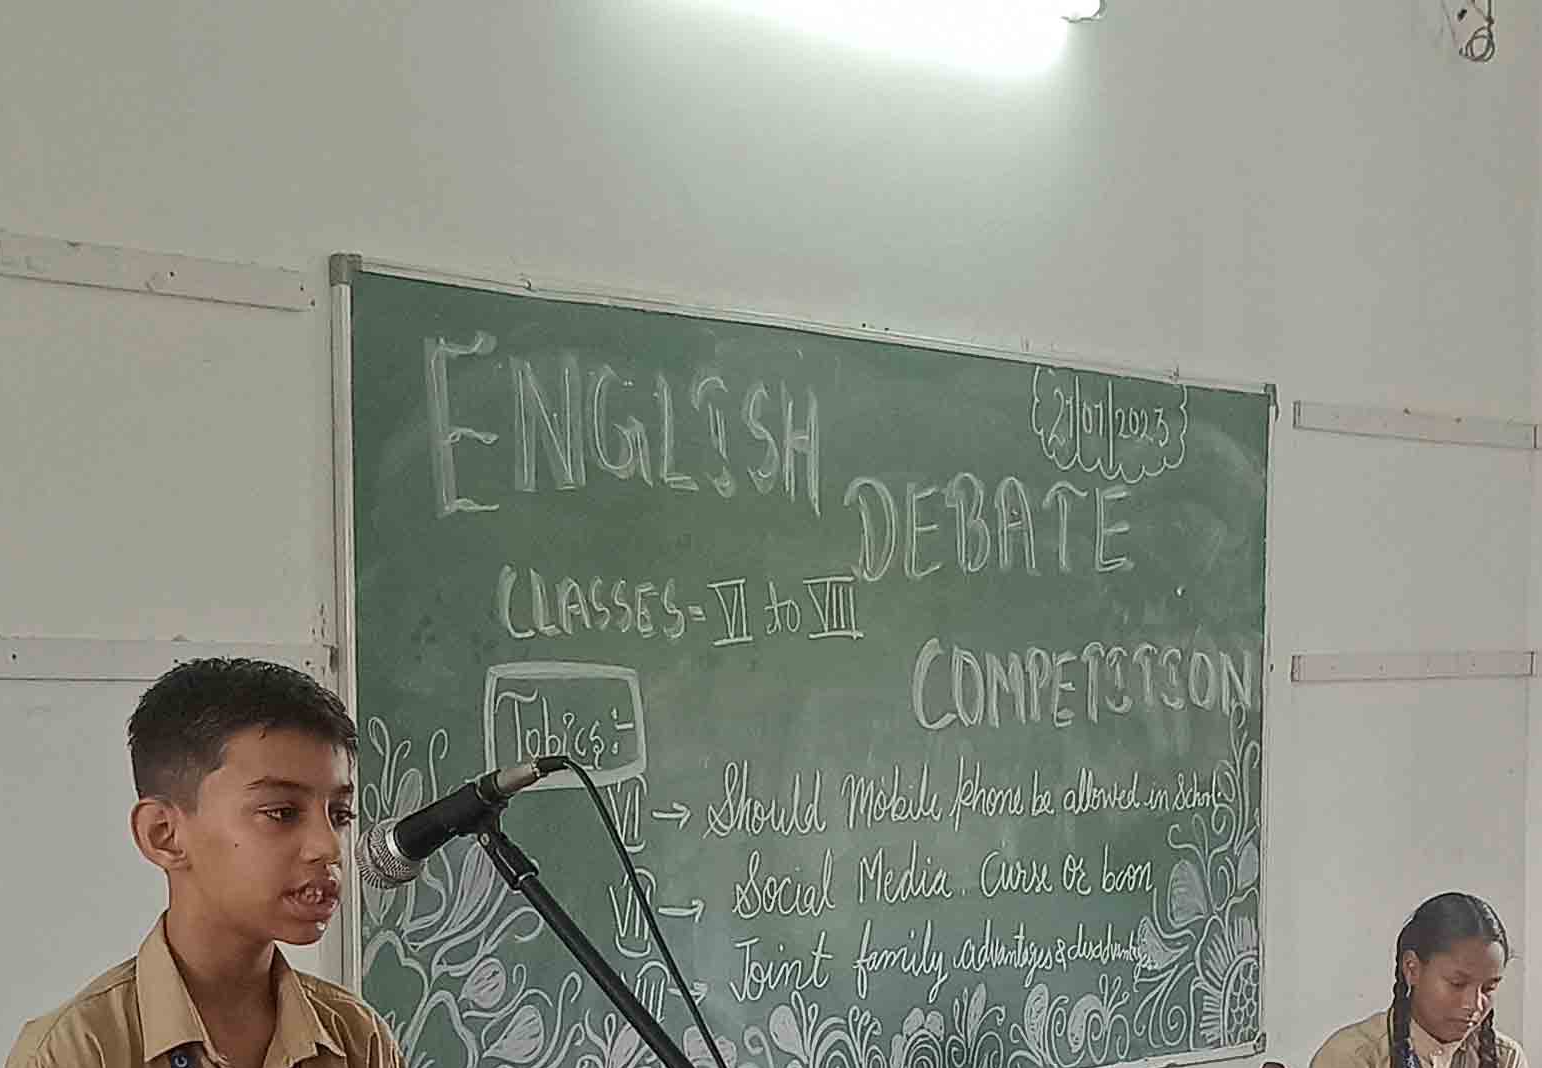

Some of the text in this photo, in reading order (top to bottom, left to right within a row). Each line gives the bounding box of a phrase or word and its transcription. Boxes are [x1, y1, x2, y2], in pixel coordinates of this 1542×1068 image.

[425, 332, 820, 518] ENGLISH
[843, 472, 1134, 582] DEBATE
[707, 578, 754, 646] VI
[764, 582, 801, 634] to
[803, 572, 864, 639] VIII
[913, 638, 1252, 730] COMPETITION
[703, 760, 827, 838] Should
[841, 763, 943, 829] Mobile
[1031, 769, 1055, 816] be
[1063, 767, 1140, 815] allowed
[1142, 788, 1170, 812] in
[732, 848, 836, 919] Social
[980, 851, 1053, 898] Curse
[730, 931, 834, 1002] Joint
[853, 919, 949, 1004] family
